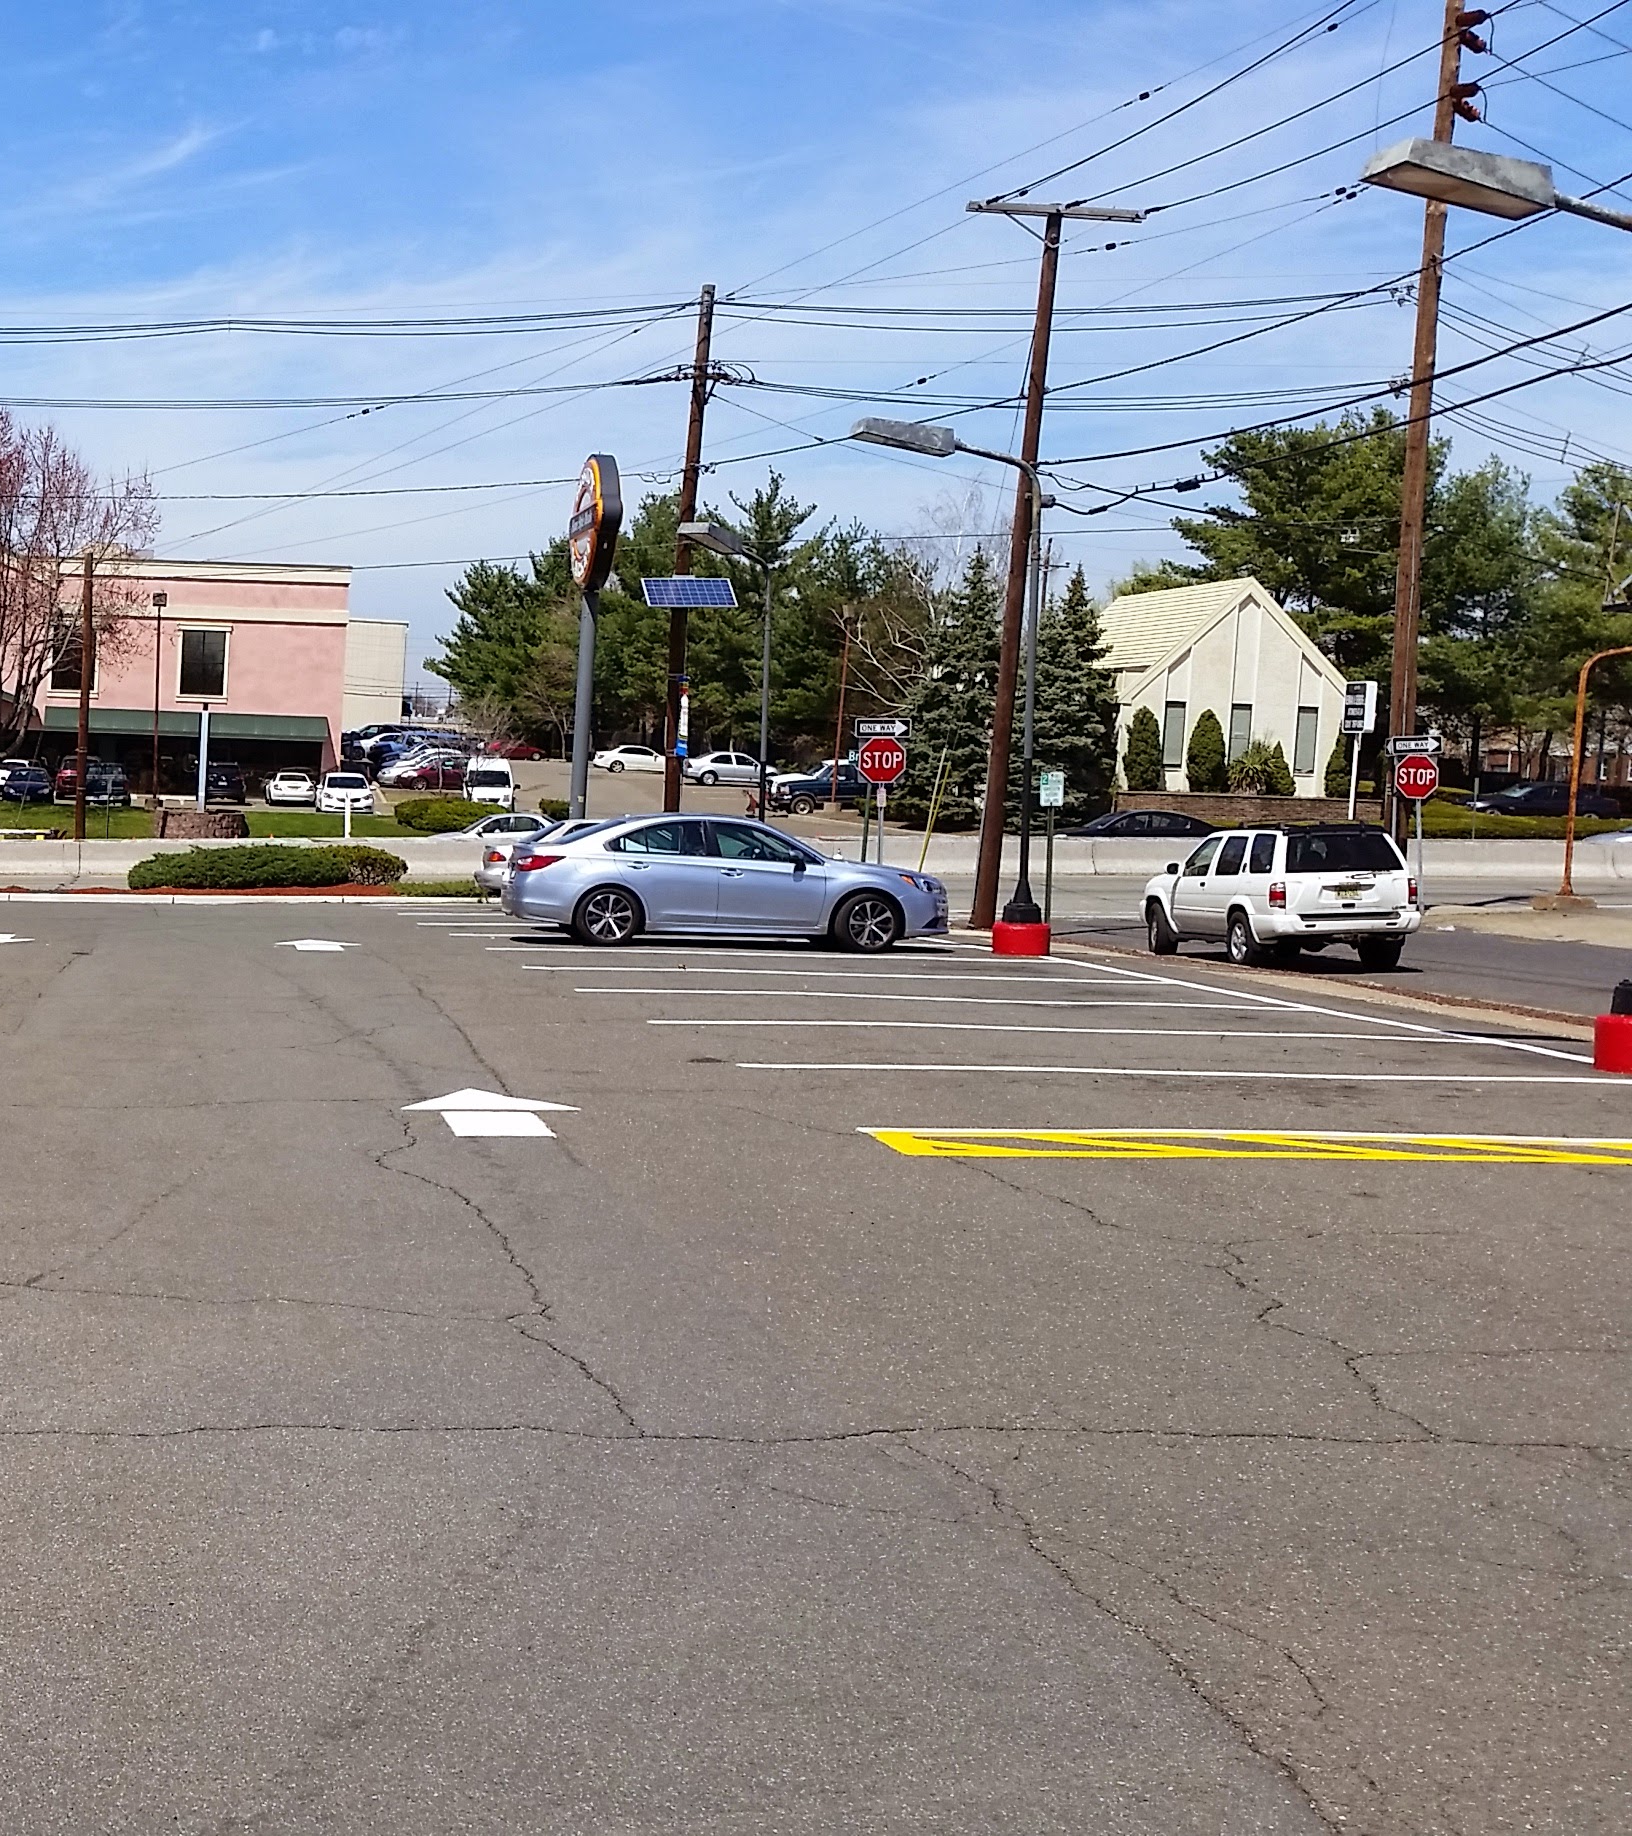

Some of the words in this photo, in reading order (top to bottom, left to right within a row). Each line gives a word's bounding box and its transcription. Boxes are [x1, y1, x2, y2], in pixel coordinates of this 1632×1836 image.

[861, 724, 877, 732] ONE
[879, 724, 896, 732] WAY
[1414, 741, 1429, 749] WAY
[862, 751, 903, 769] STOP
[1041, 774, 1048, 784] 2
[1398, 767, 1436, 785] STOP
